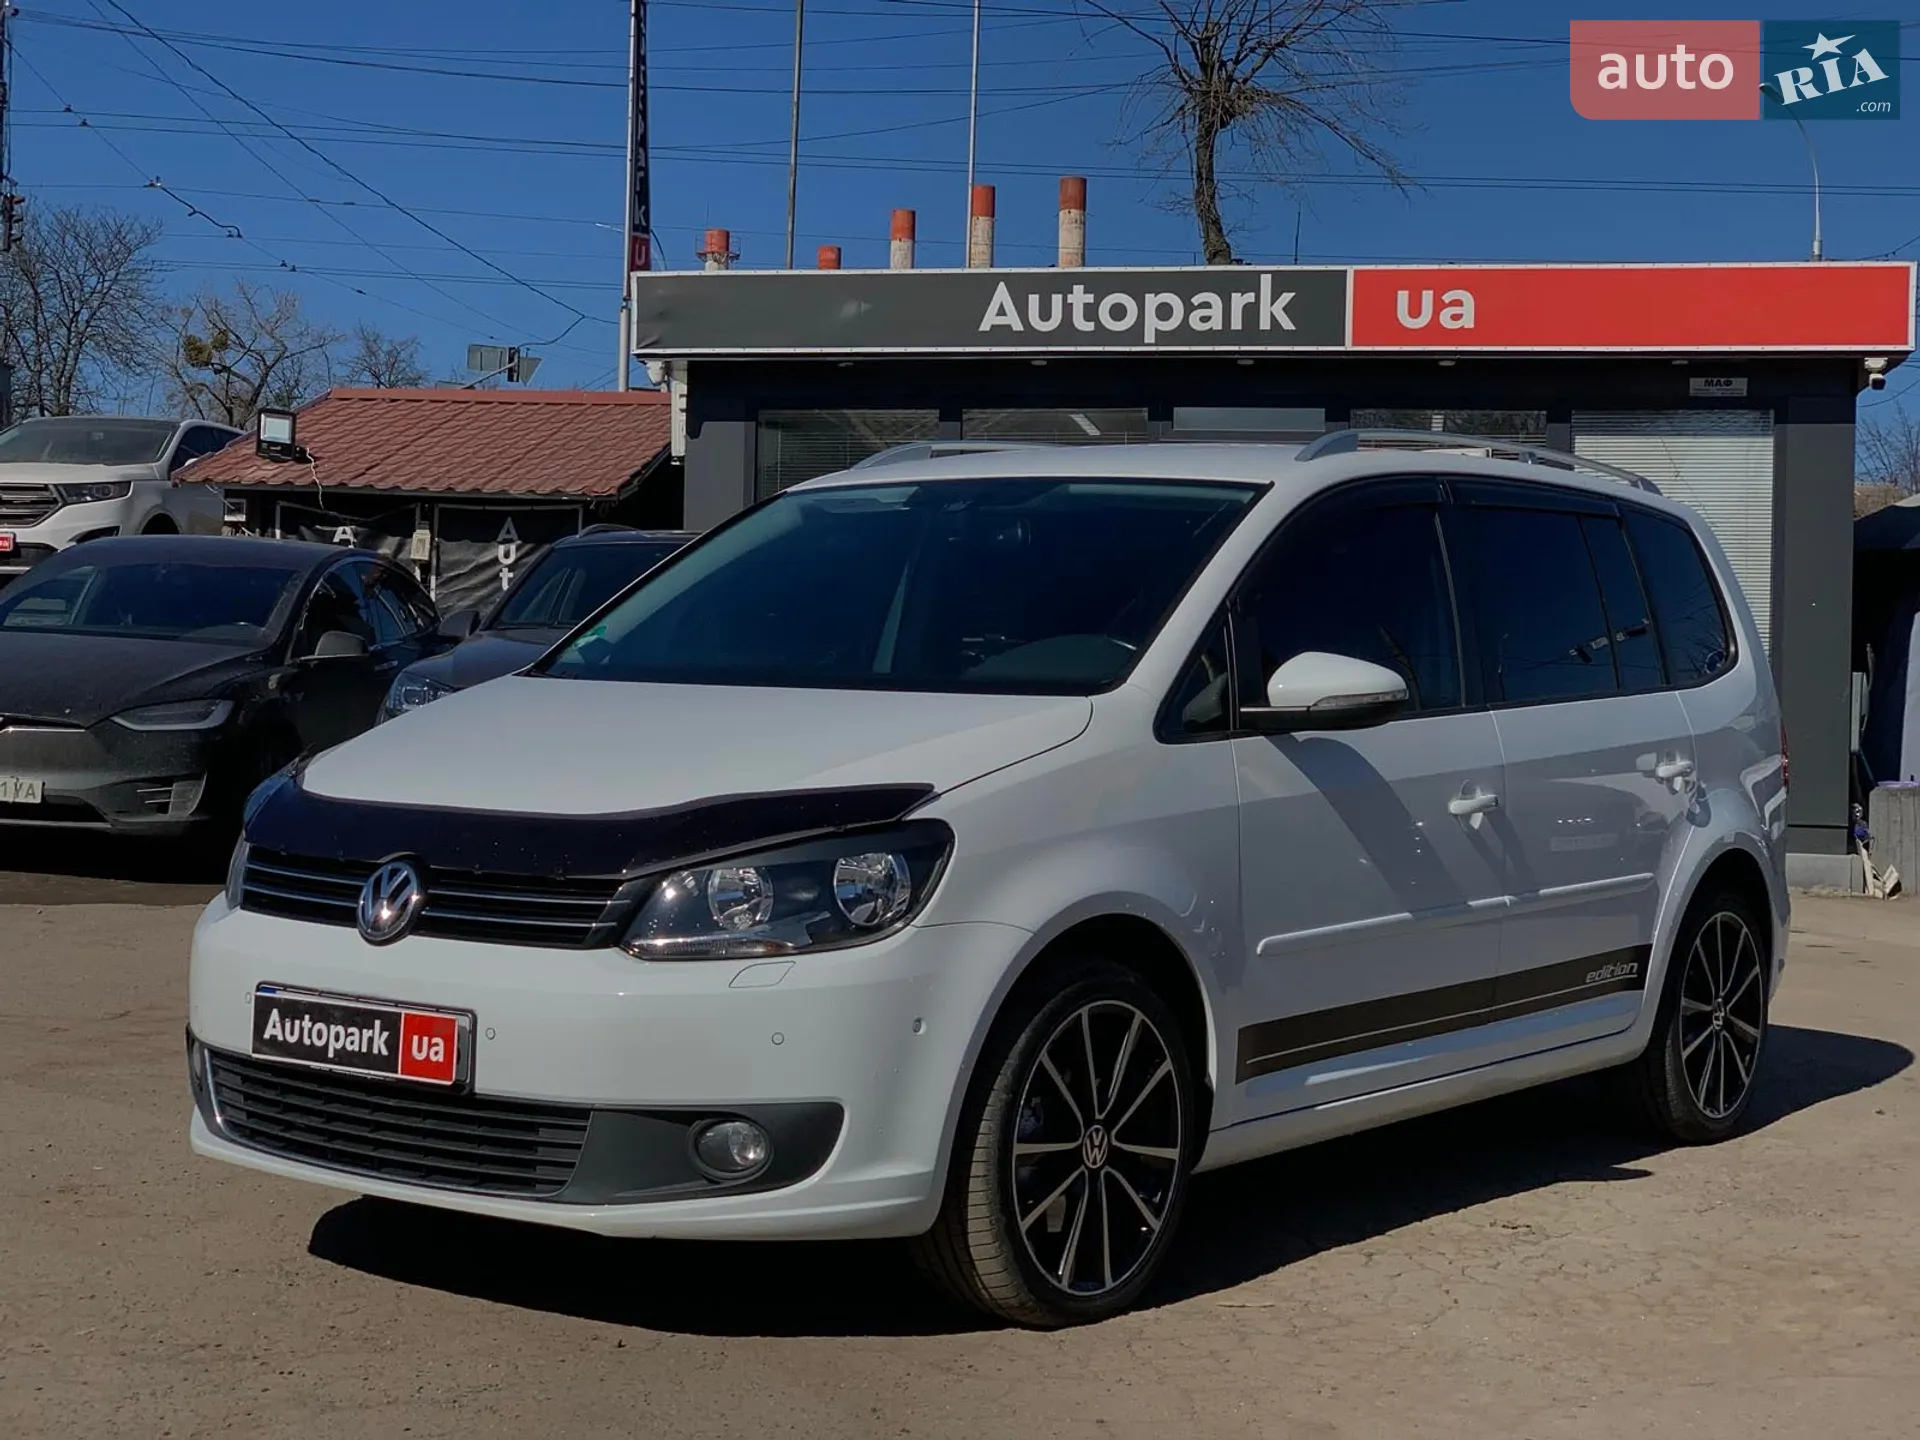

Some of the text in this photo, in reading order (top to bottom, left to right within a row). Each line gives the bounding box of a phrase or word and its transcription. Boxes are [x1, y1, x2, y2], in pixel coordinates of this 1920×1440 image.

[978, 273, 1475, 344] Autopark ua
[1585, 961, 1638, 983] edition
[263, 1007, 445, 1063] Autopark ua
